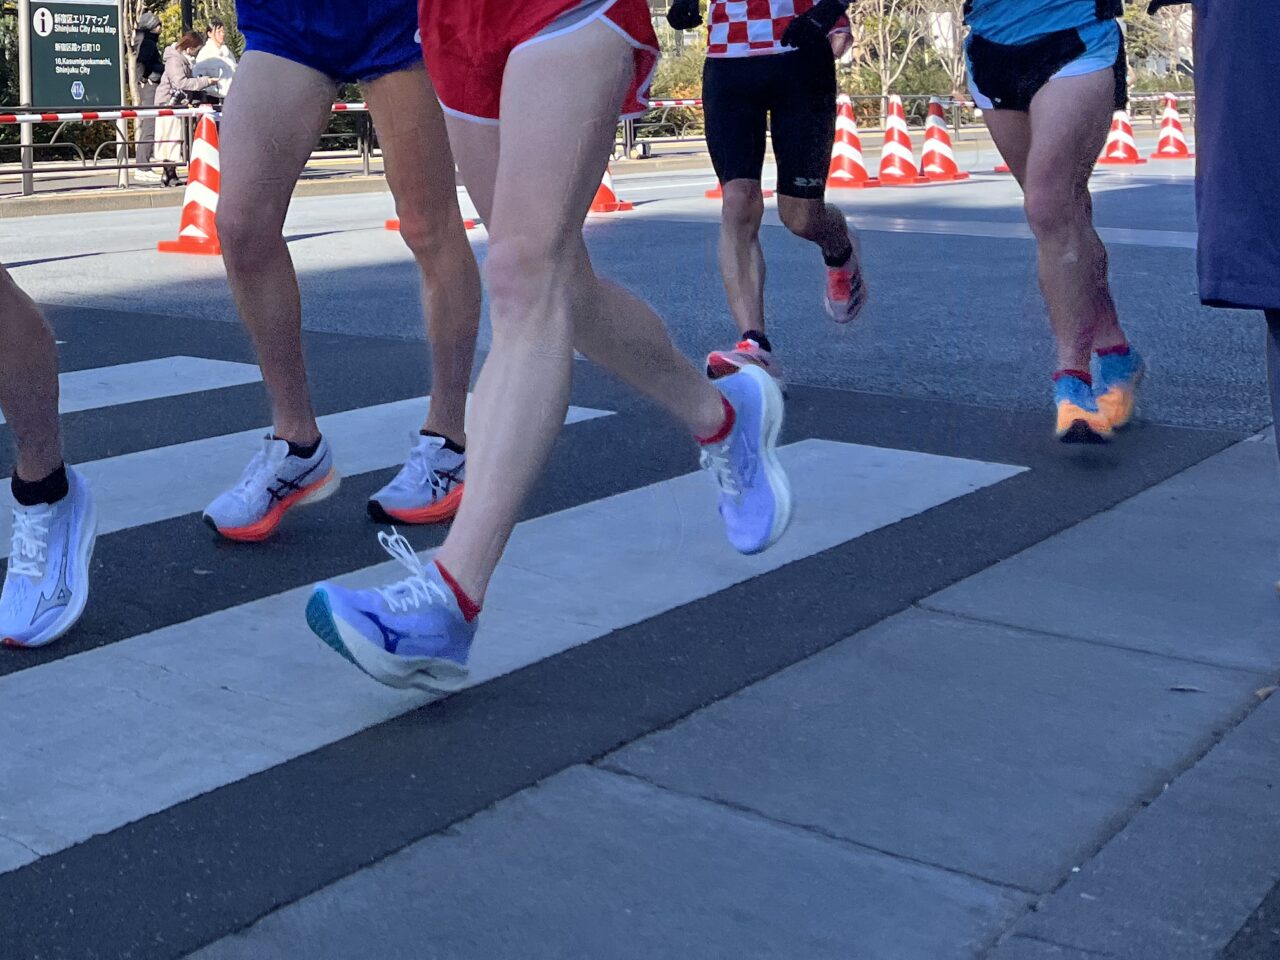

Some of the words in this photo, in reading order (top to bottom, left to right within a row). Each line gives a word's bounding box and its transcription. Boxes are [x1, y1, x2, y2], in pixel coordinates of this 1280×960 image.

[54, 24, 78, 34] Shinjuku
[79, 25, 90, 35] City
[91, 25, 104, 33] Area
[105, 26, 117, 36] Map
